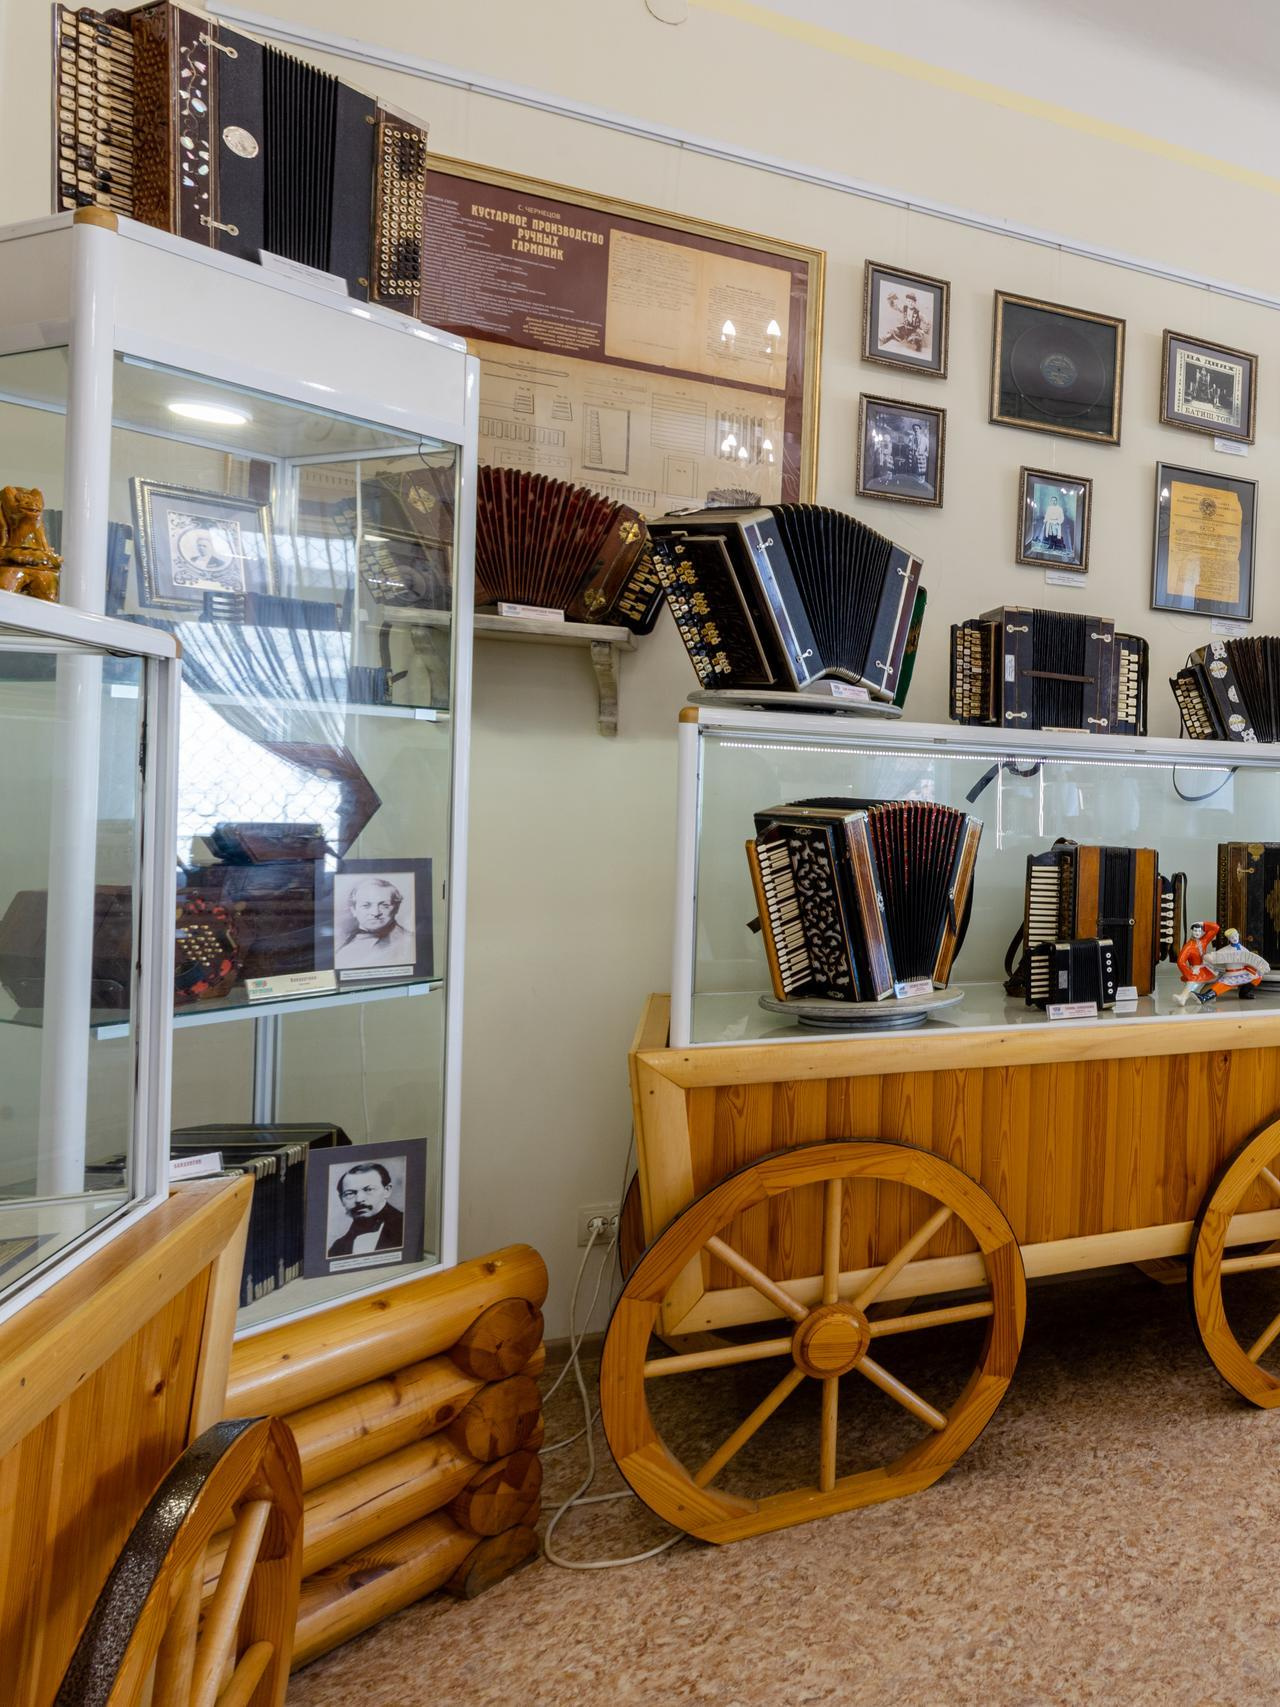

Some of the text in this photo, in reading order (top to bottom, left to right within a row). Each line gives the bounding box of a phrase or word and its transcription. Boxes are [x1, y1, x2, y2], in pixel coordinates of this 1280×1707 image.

[471, 204, 528, 228] КУСТАРНОЕ
[532, 218, 604, 246] ПРОИЗВОДСТВО
[518, 228, 559, 248] РУЧНЫХ
[511, 239, 564, 261] ГАРМОНИК
